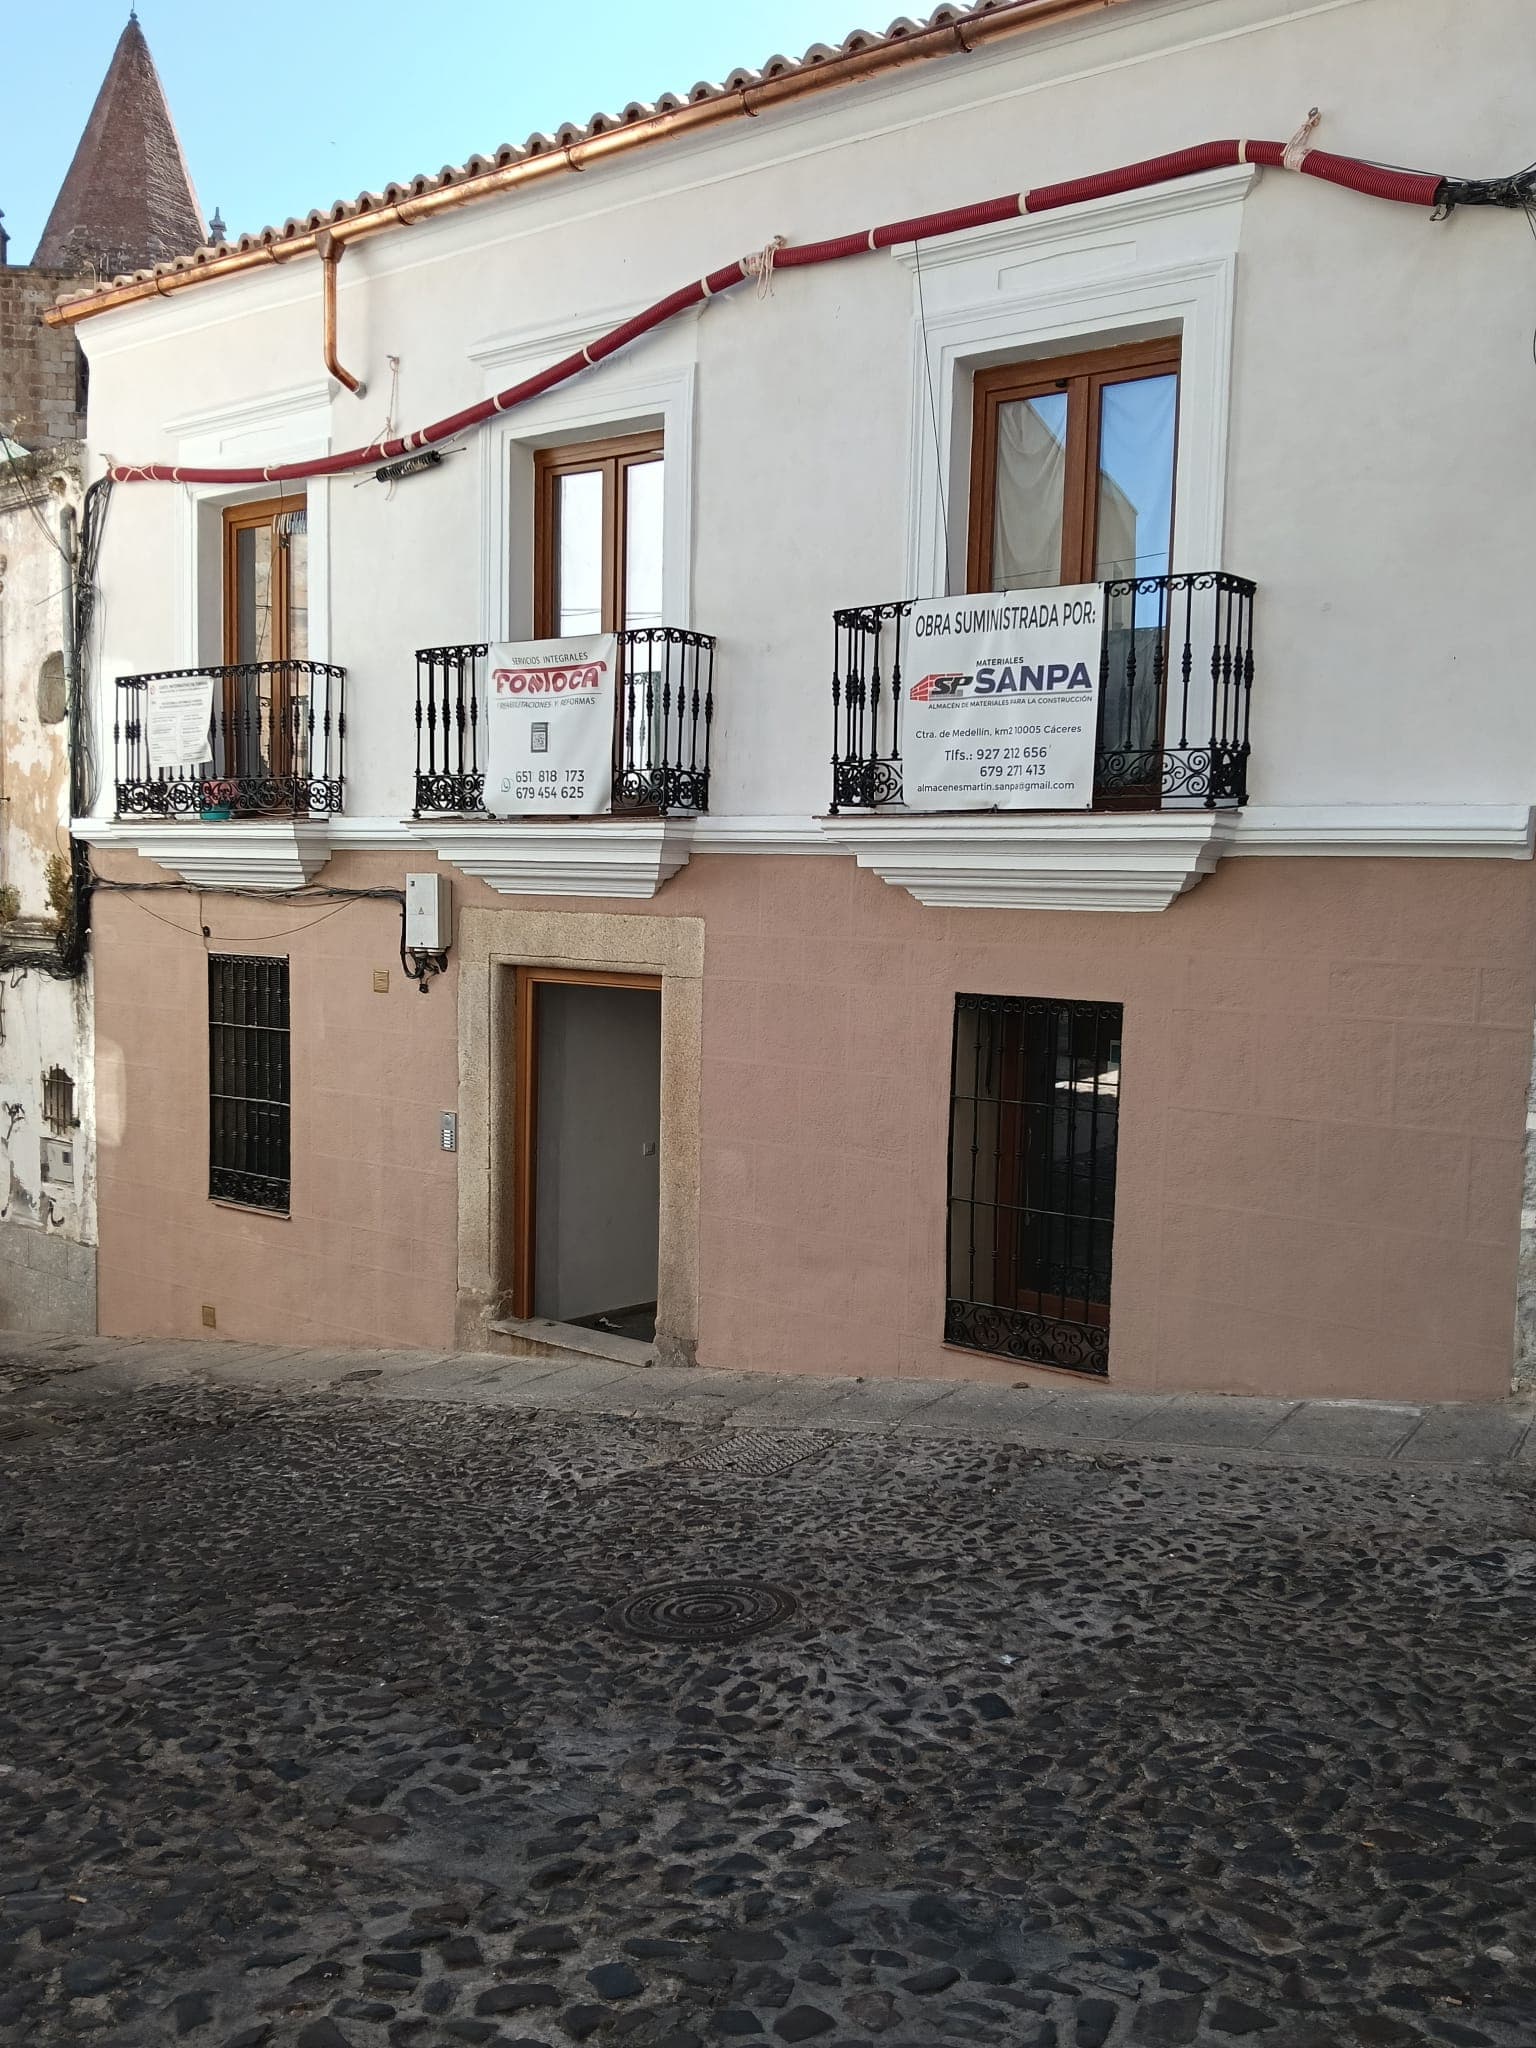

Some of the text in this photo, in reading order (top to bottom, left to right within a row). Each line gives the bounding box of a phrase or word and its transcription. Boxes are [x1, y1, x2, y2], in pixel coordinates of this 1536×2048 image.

[915, 601, 1096, 638] OBRA SUMINISTRADA POR:
[511, 652, 589, 665] SERVICIOS INTEGRALES
[976, 656, 1024, 667] MATERIALES
[492, 660, 608, 694] FONTOCA
[974, 662, 1093, 694] SANPA
[931, 676, 974, 695] SP
[970, 699, 1010, 707] MATERIALES
[1037, 695, 1093, 704] CONSTRUCCIÓN
[915, 730, 937, 739] Ctra.
[939, 730, 950, 738] de
[1014, 725, 1041, 734] 10005
[1043, 724, 1082, 734] Cáceres
[945, 747, 1047, 761] Tlfs.: 927 212 656
[515, 769, 585, 783] 651 818 173
[980, 764, 1046, 777] 679 271 413
[515, 786, 584, 799] 679 454 625
